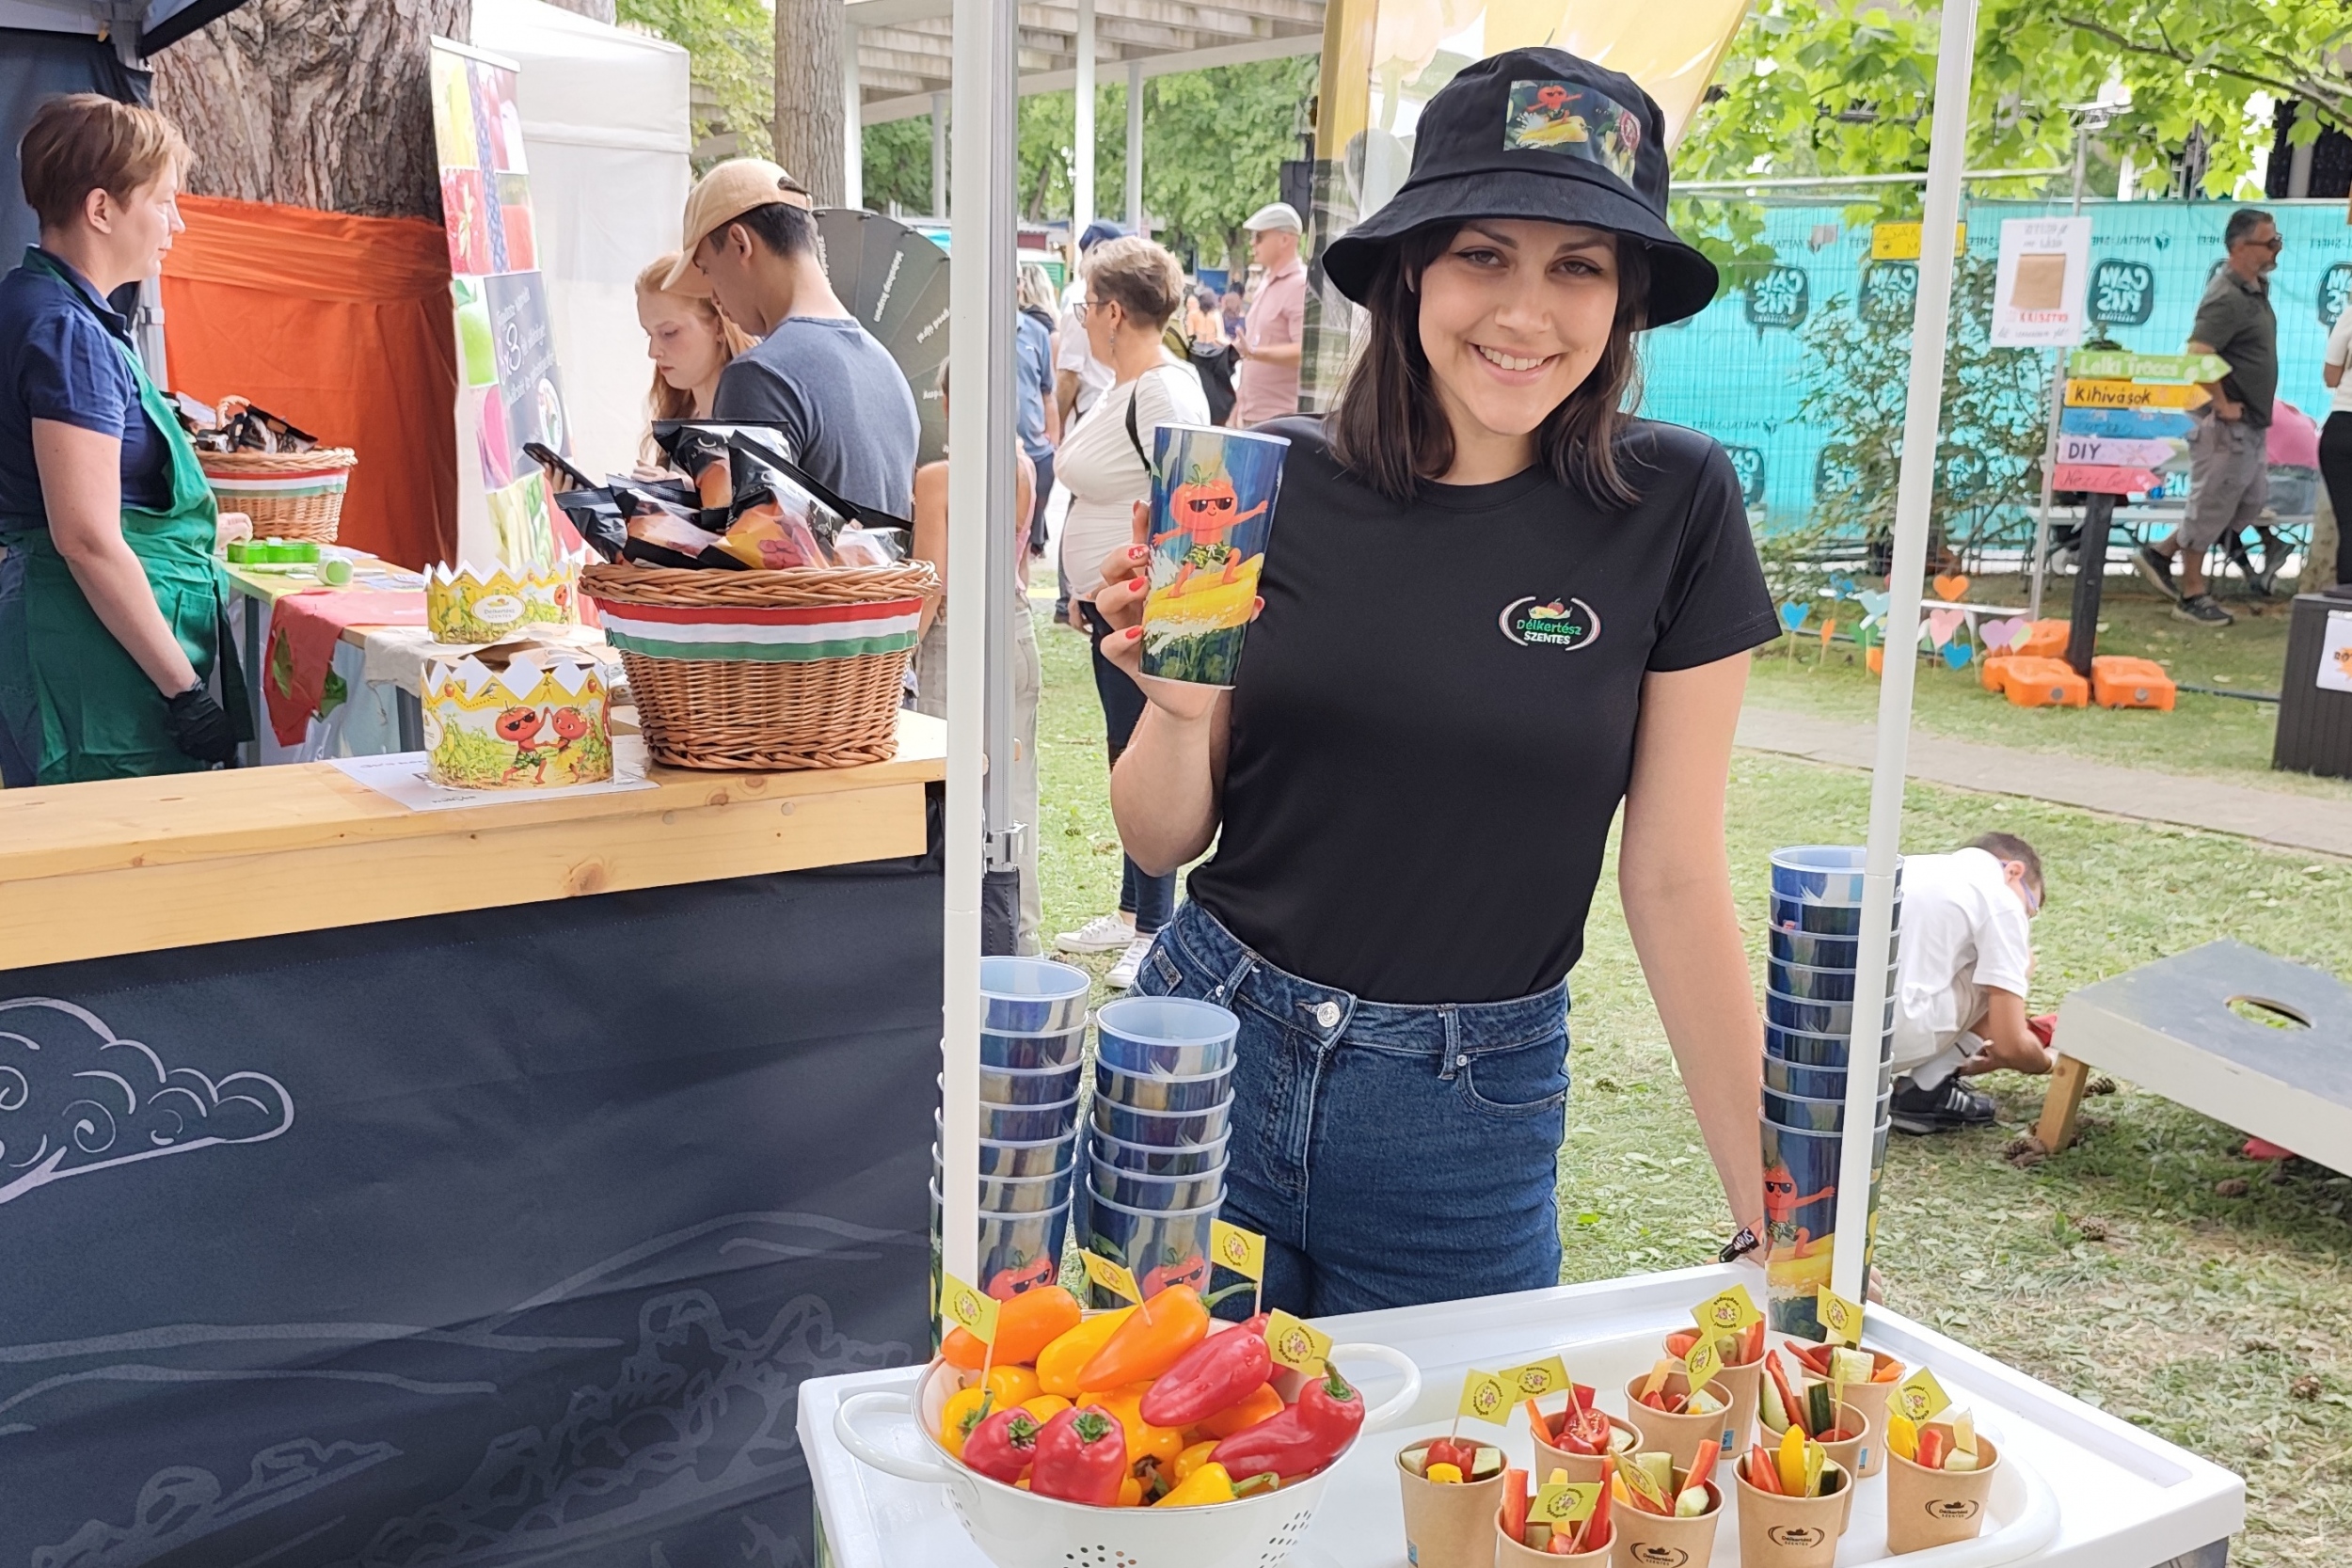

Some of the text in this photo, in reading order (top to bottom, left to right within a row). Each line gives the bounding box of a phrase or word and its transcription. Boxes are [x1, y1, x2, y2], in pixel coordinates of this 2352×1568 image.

[873, 293, 891, 323] kupon
[2068, 442, 2102, 460] DIY
[1516, 618, 1582, 635] Délkertész
[1523, 630, 1571, 644] SZENTES
